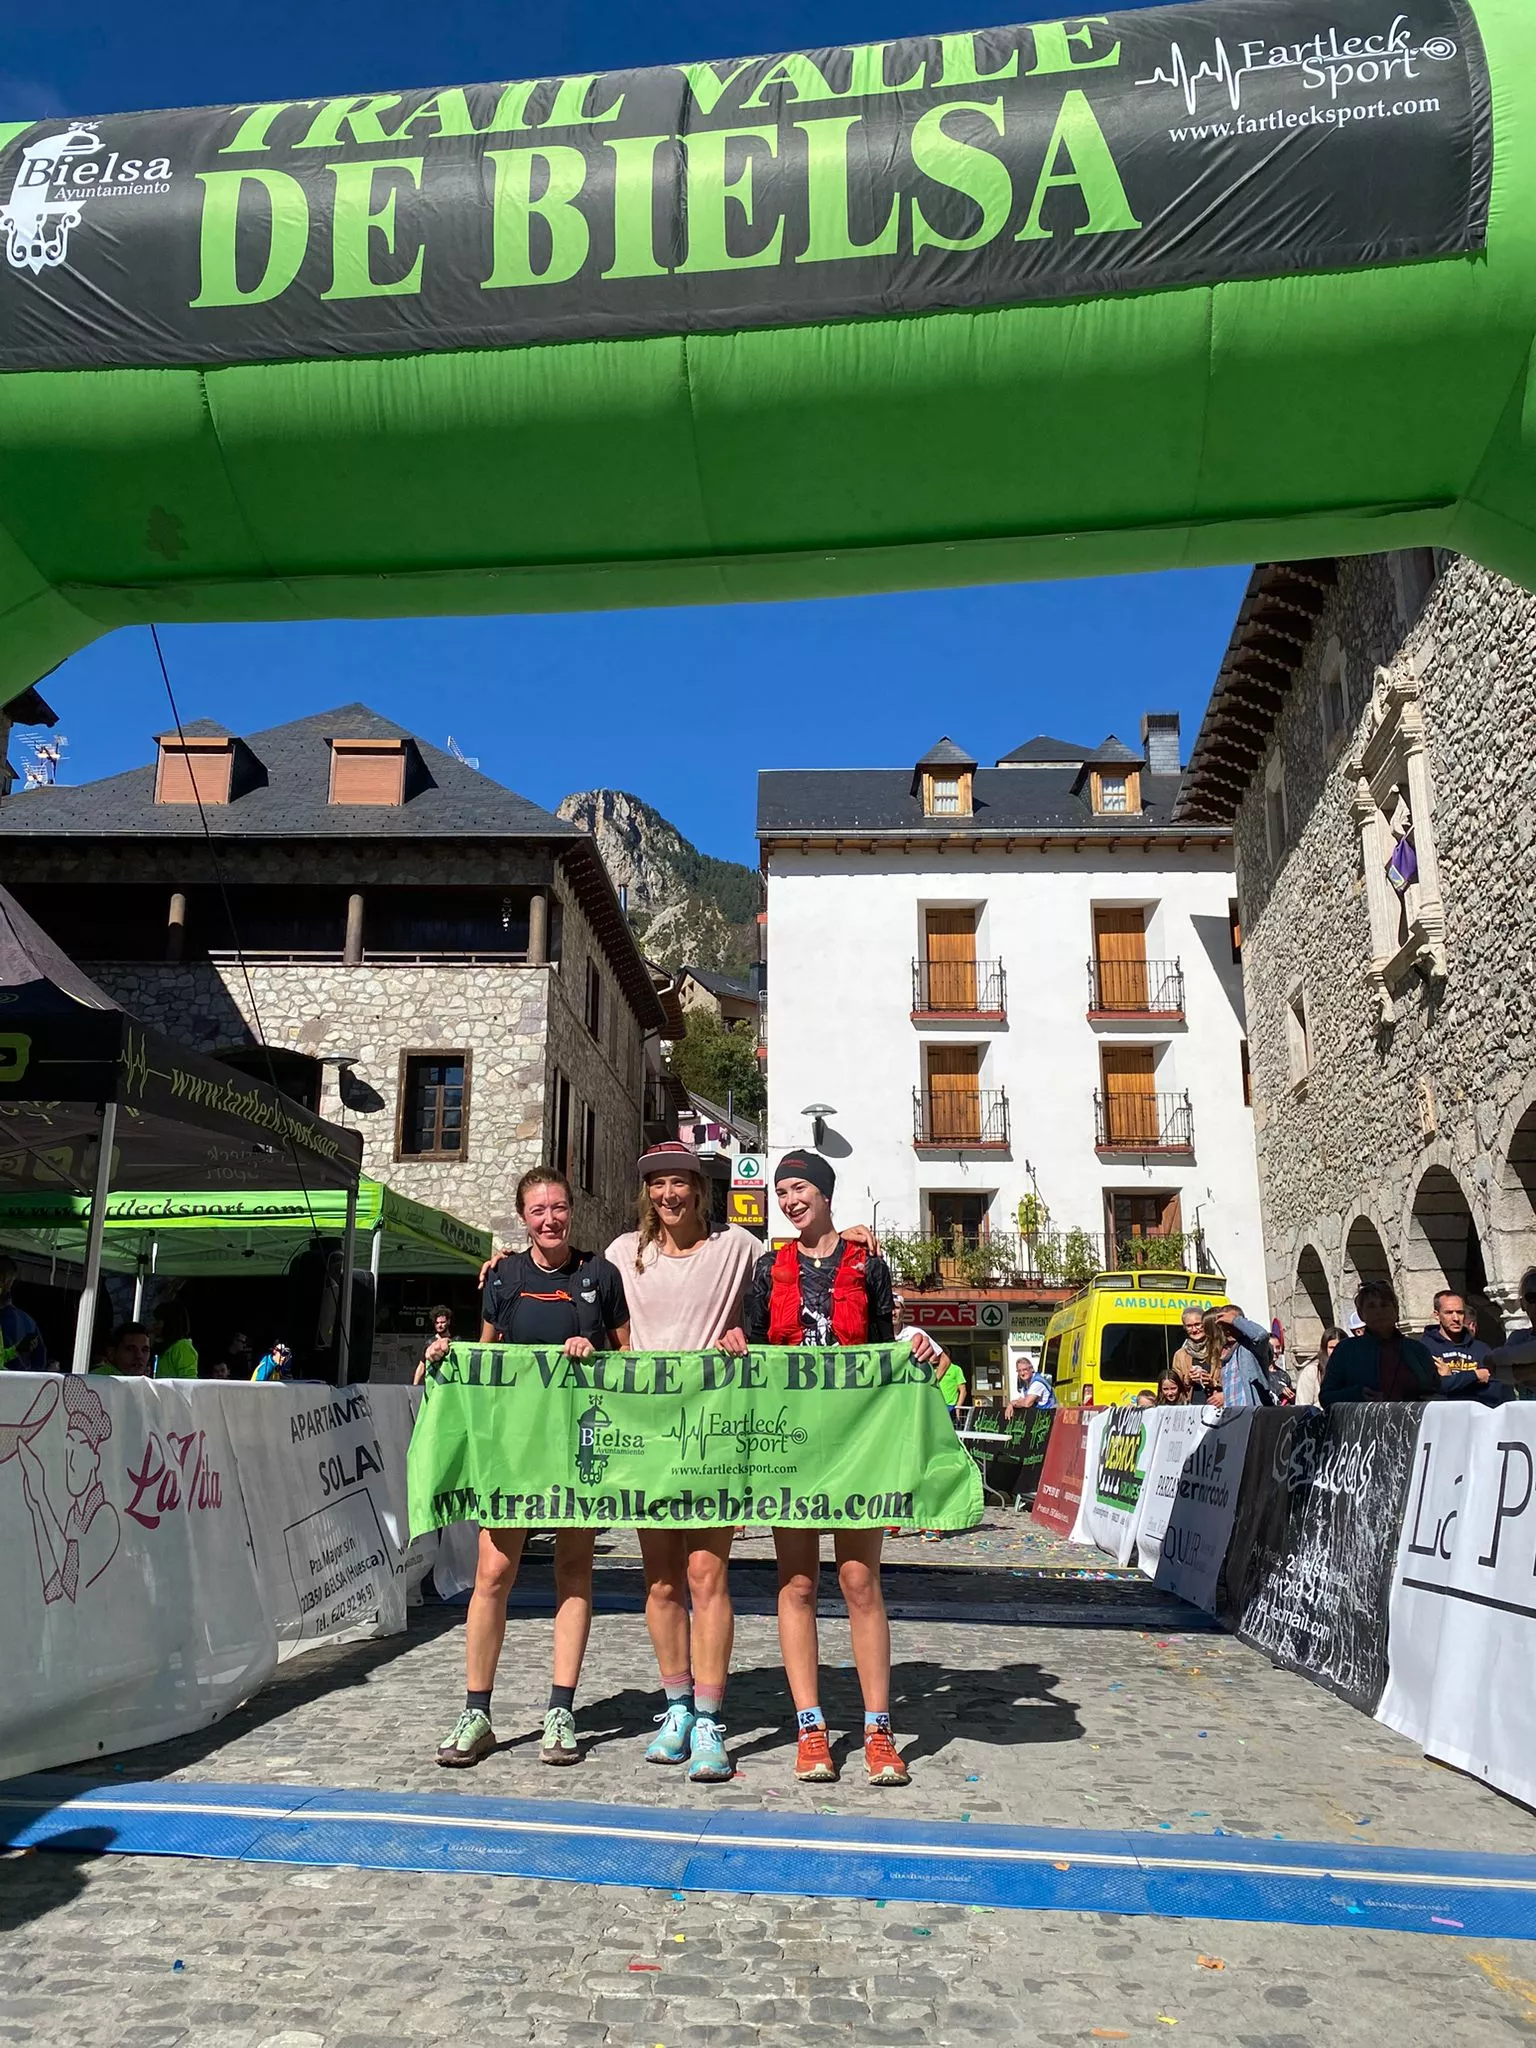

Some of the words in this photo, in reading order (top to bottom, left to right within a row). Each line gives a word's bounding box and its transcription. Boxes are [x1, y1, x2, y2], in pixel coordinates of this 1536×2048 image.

[1237, 14, 1411, 70] Fartleck
[218, 75, 626, 154] TRAIL
[687, 15, 1122, 118] VALLE
[1302, 49, 1421, 99] Sport
[1168, 93, 1441, 143] www.fartlecksport.com
[20, 153, 173, 187] Bielsa
[54, 180, 171, 202] Ayuntamiento
[189, 156, 426, 309] DE
[480, 88, 1143, 291] BIELSA
[902, 1309, 975, 1323] SPAR
[1114, 1297, 1213, 1311] AMBULANCIA
[532, 1350, 684, 1395] VALLE
[699, 1349, 769, 1392] DE
[783, 1348, 938, 1391] BIELS
[709, 1405, 789, 1435] Fartleck
[580, 1428, 646, 1449] Bielsa
[596, 1447, 646, 1457] Ayuntamiento
[735, 1431, 789, 1454] Sport
[671, 1462, 798, 1476] www.fartlecksport.com
